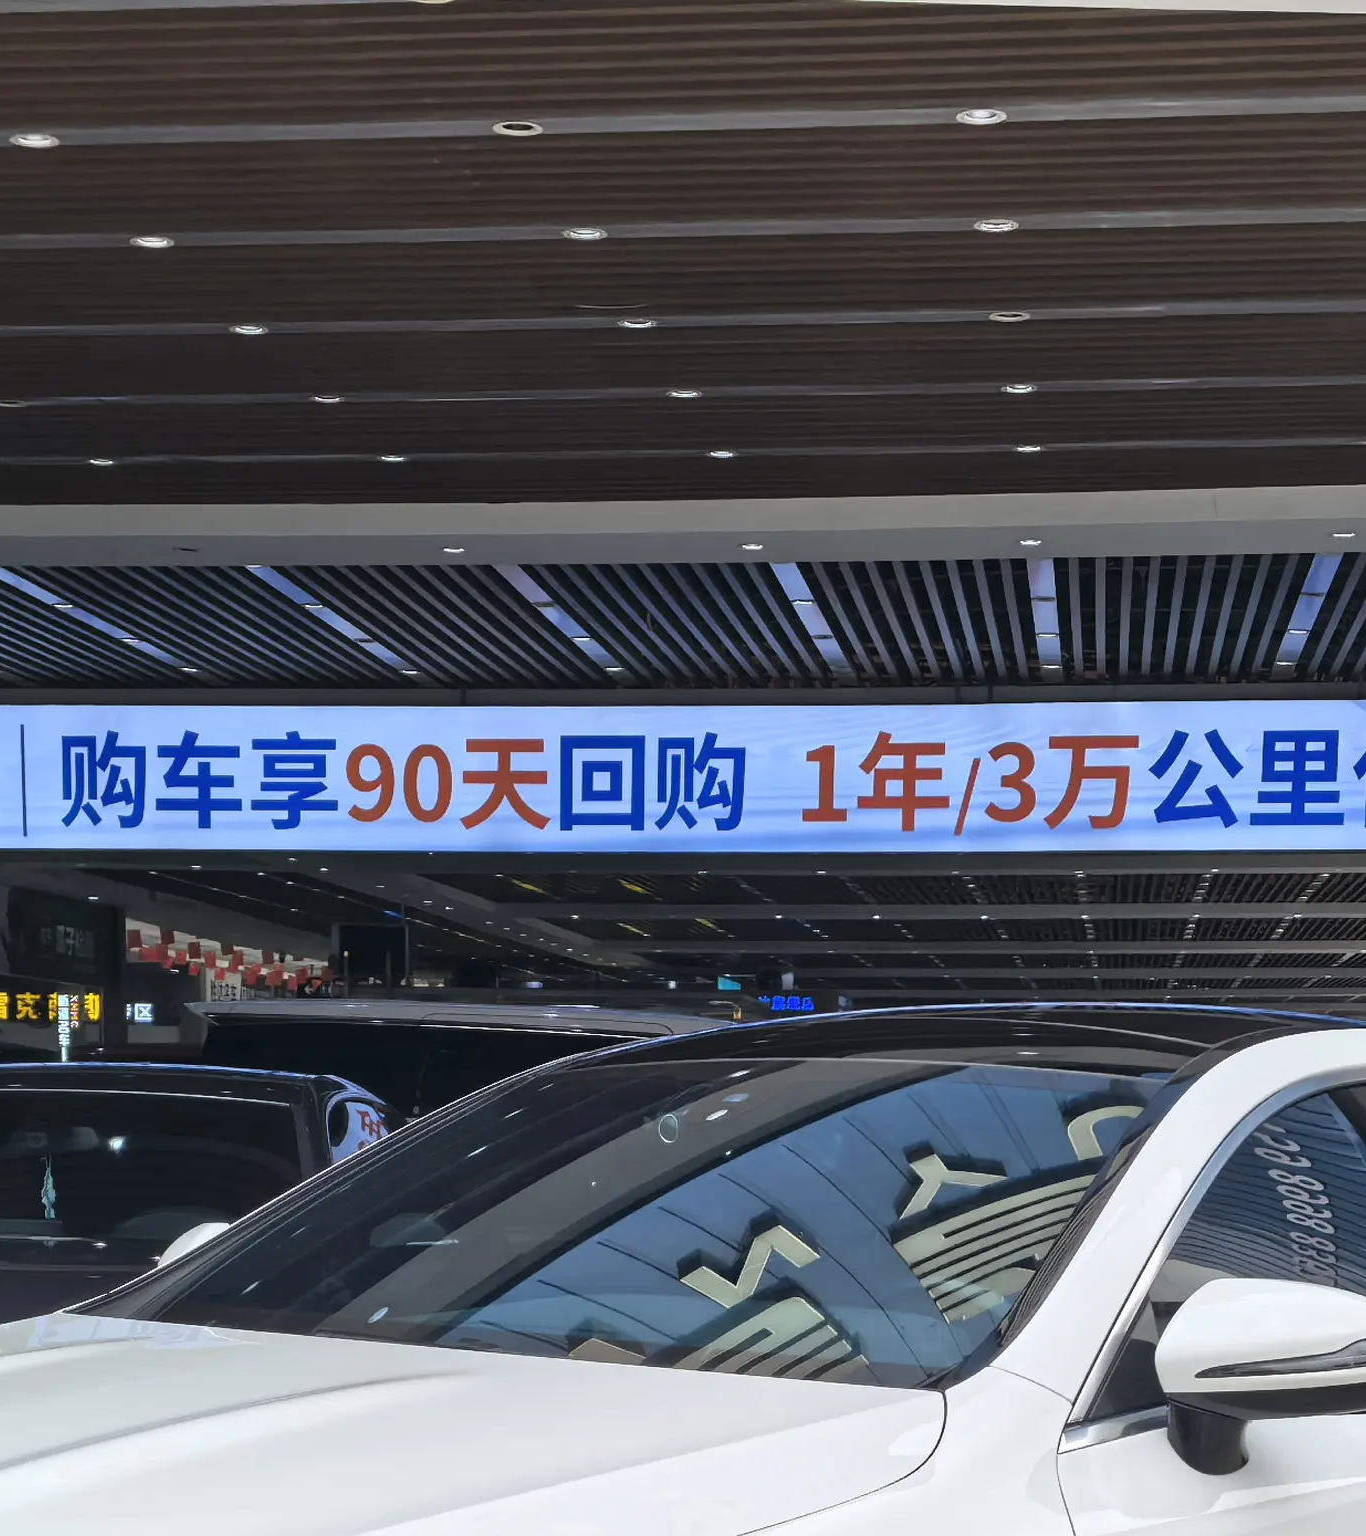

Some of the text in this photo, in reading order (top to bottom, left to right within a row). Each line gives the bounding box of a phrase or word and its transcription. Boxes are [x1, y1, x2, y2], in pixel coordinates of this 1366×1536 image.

[61, 729, 748, 833] 购车享90天回购
